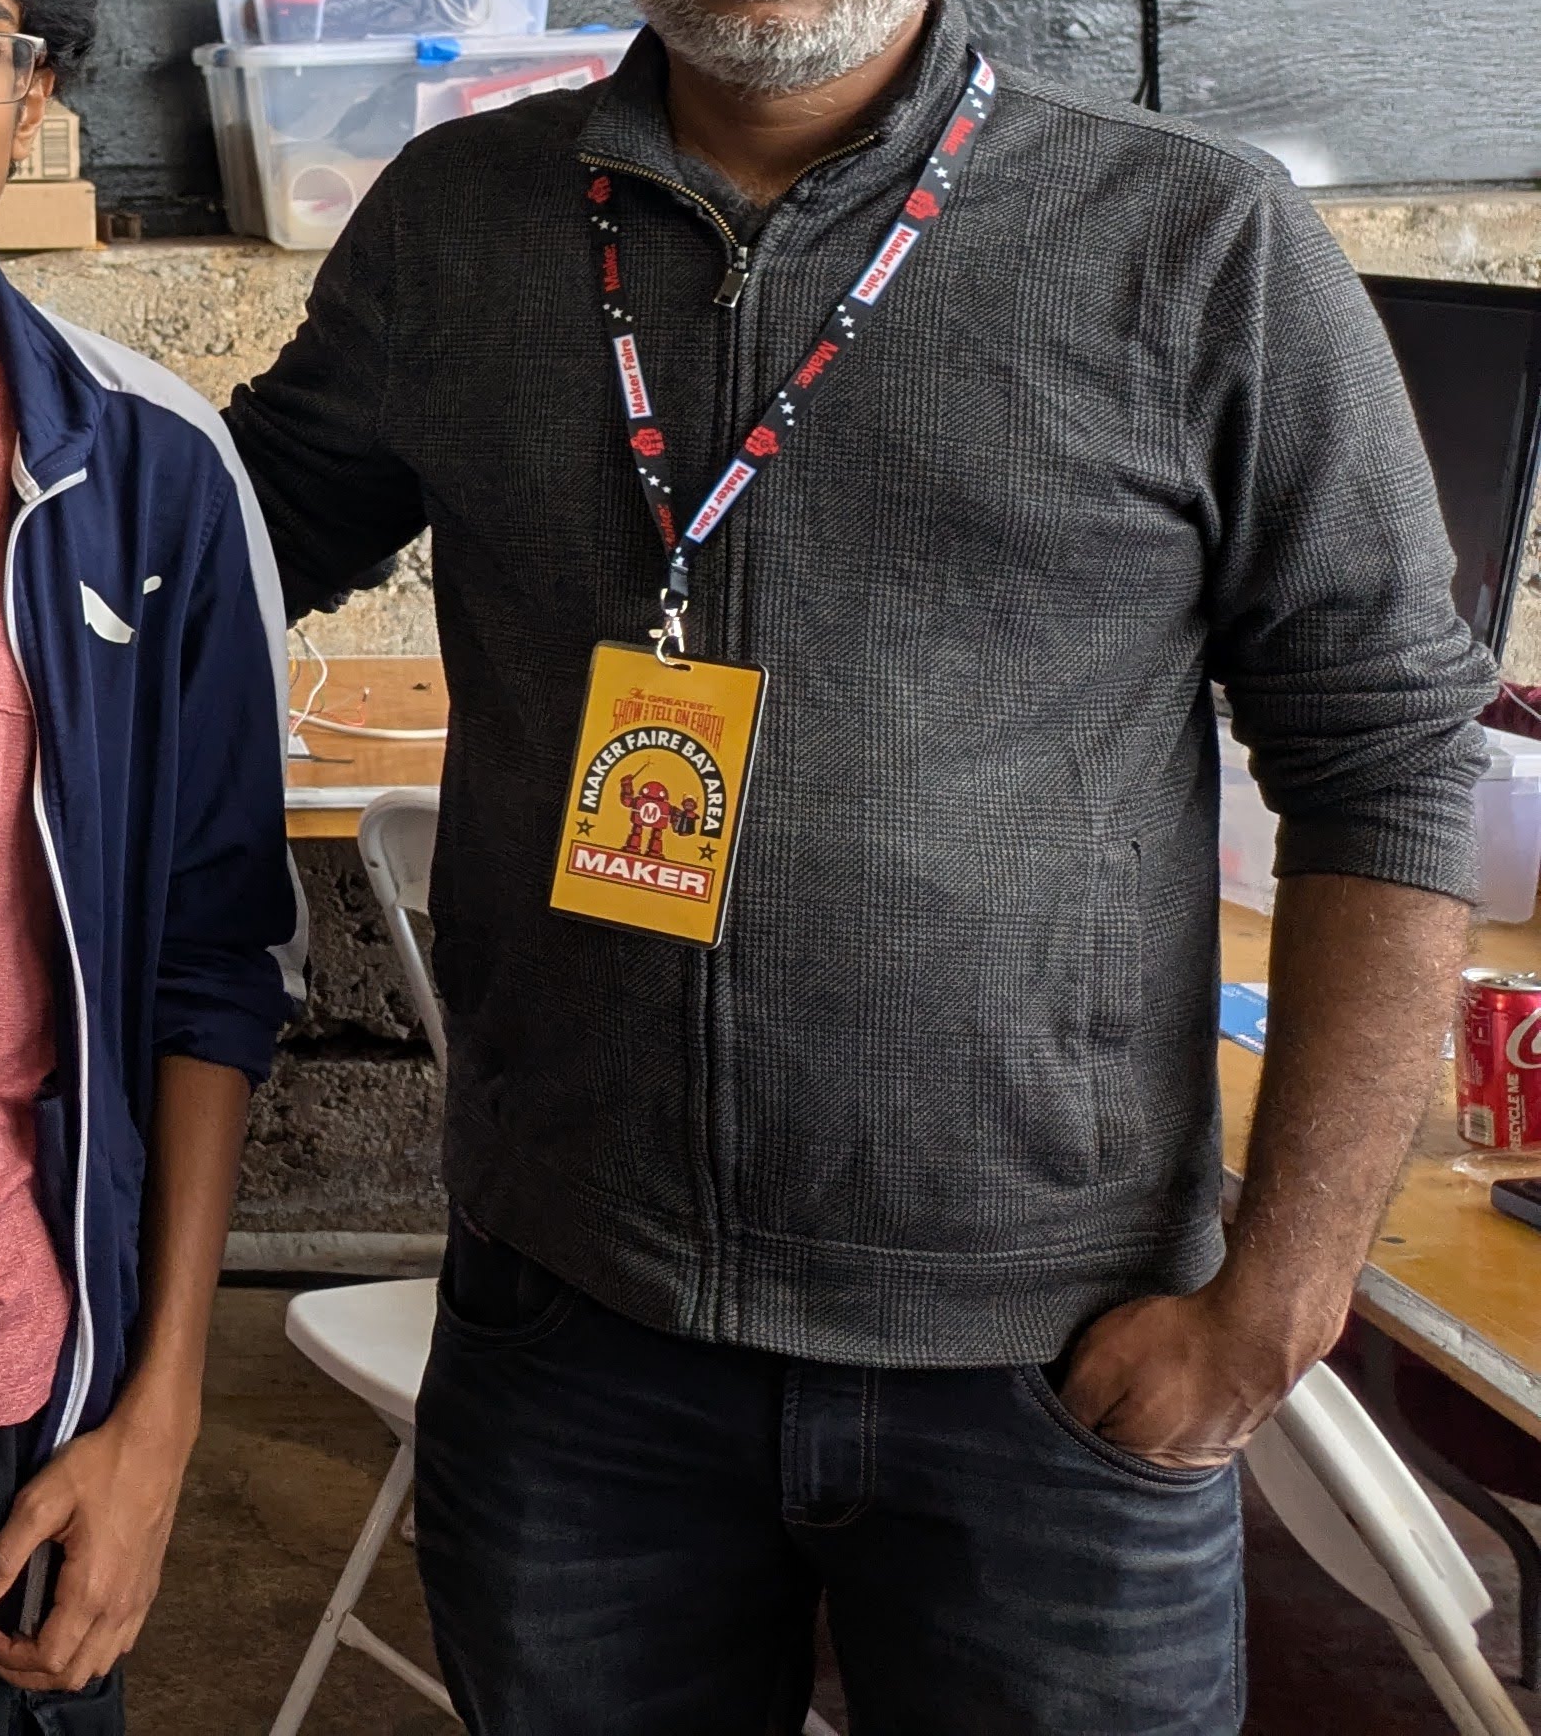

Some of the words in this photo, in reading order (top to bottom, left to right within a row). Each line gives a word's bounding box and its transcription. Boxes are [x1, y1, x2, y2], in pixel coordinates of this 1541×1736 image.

[881, 228, 913, 271] Maker
[858, 267, 887, 298] Faire
[621, 338, 635, 372] Faire
[793, 340, 839, 389] Make:
[627, 373, 647, 415] Maker
[714, 466, 749, 505] Maker
[691, 504, 720, 536] Faire
[651, 704, 672, 722] TELL
[691, 711, 725, 753] EARTH
[582, 742, 626, 808] MAKER
[625, 730, 682, 750] FAIRE
[681, 741, 716, 775] BAY
[704, 778, 723, 831] AREA
[574, 849, 706, 895] MAKER
